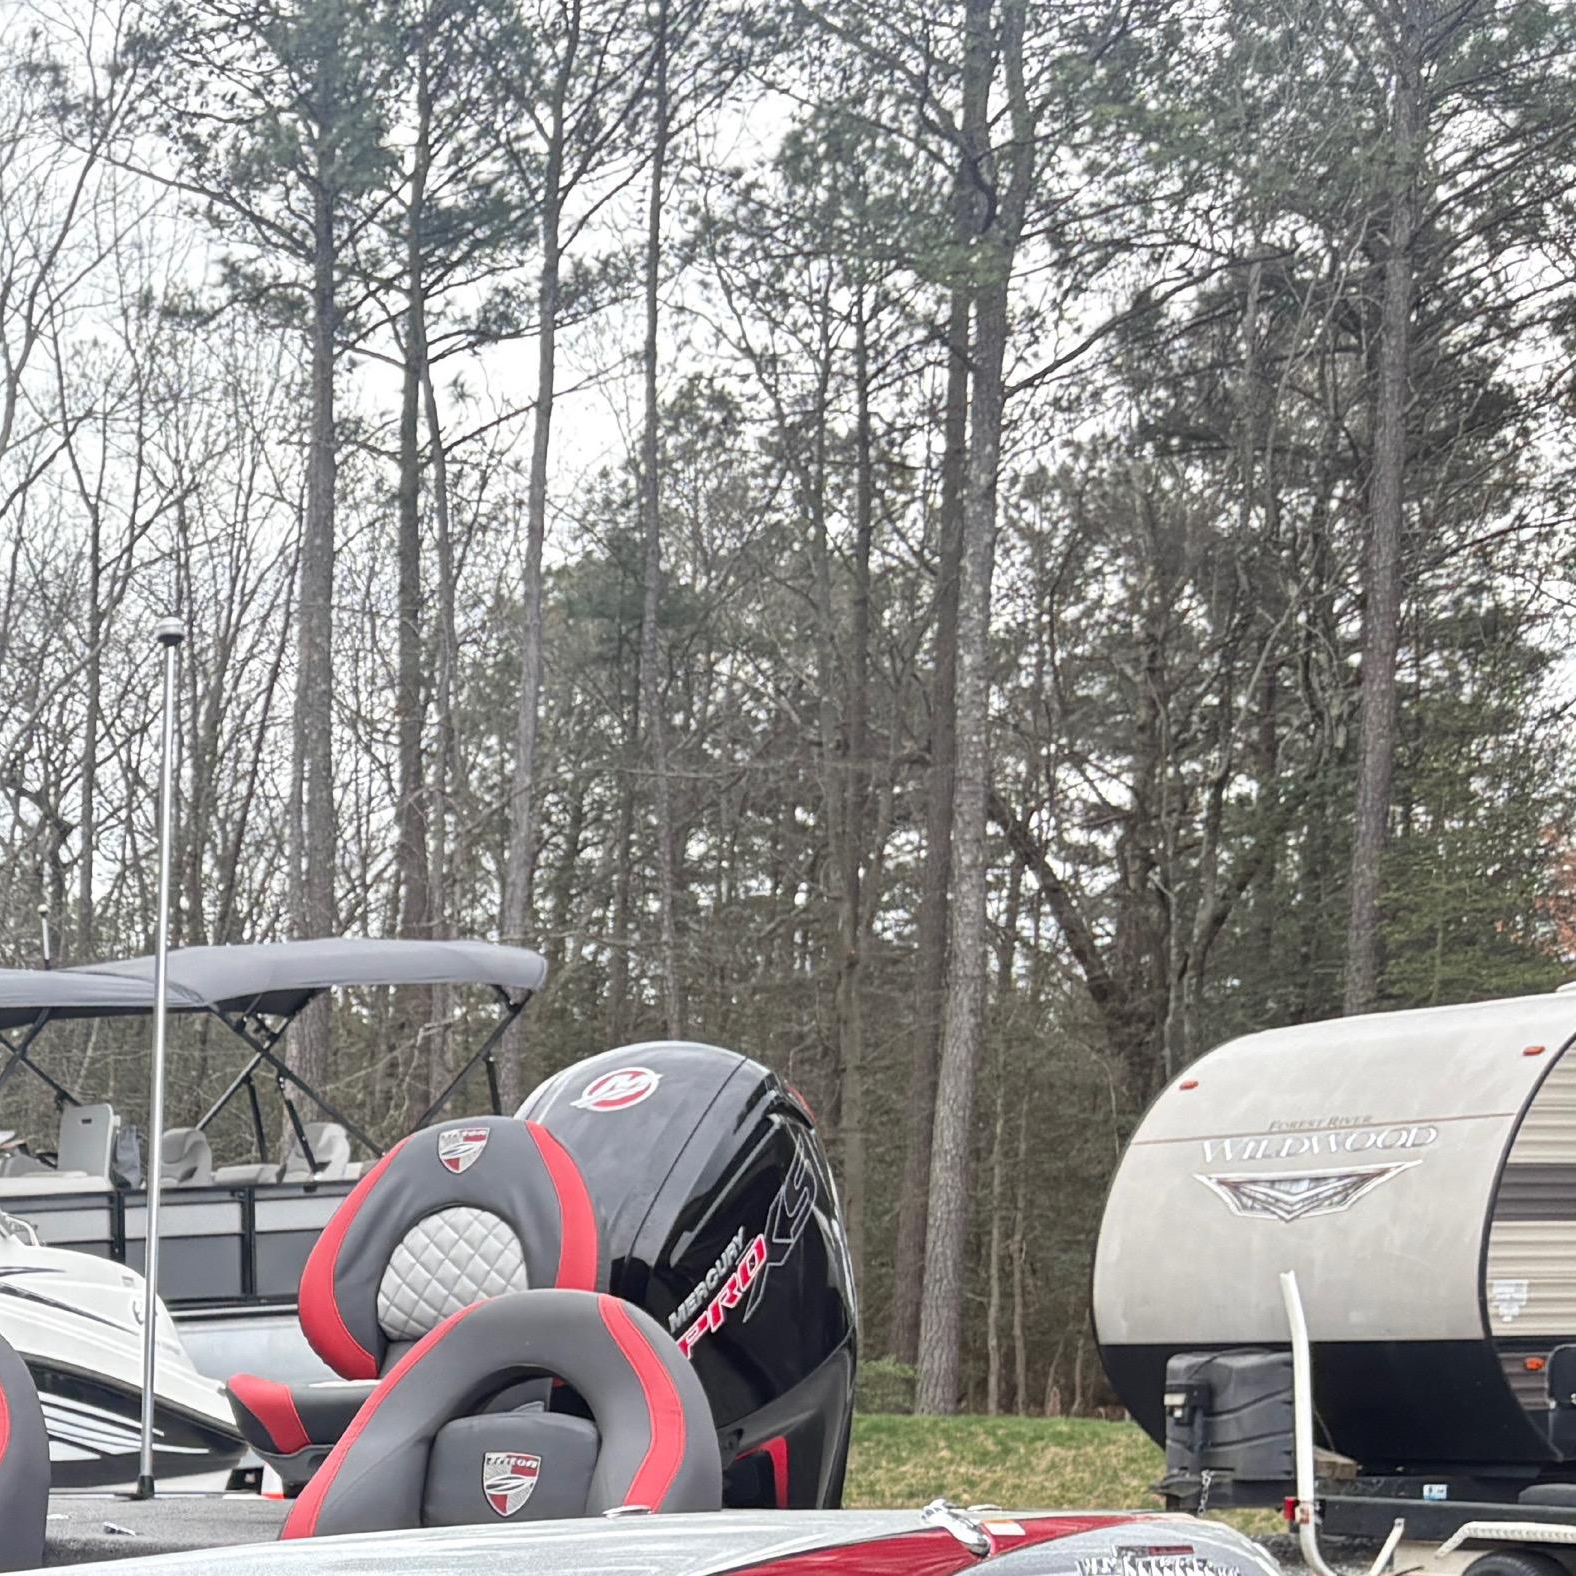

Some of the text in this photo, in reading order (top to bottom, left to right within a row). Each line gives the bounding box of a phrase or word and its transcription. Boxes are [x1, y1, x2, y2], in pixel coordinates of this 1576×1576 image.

[1202, 1126, 1440, 1163] WILDWOOD
[667, 1225, 745, 1333] MERCURY
[676, 1232, 768, 1360] PRO
